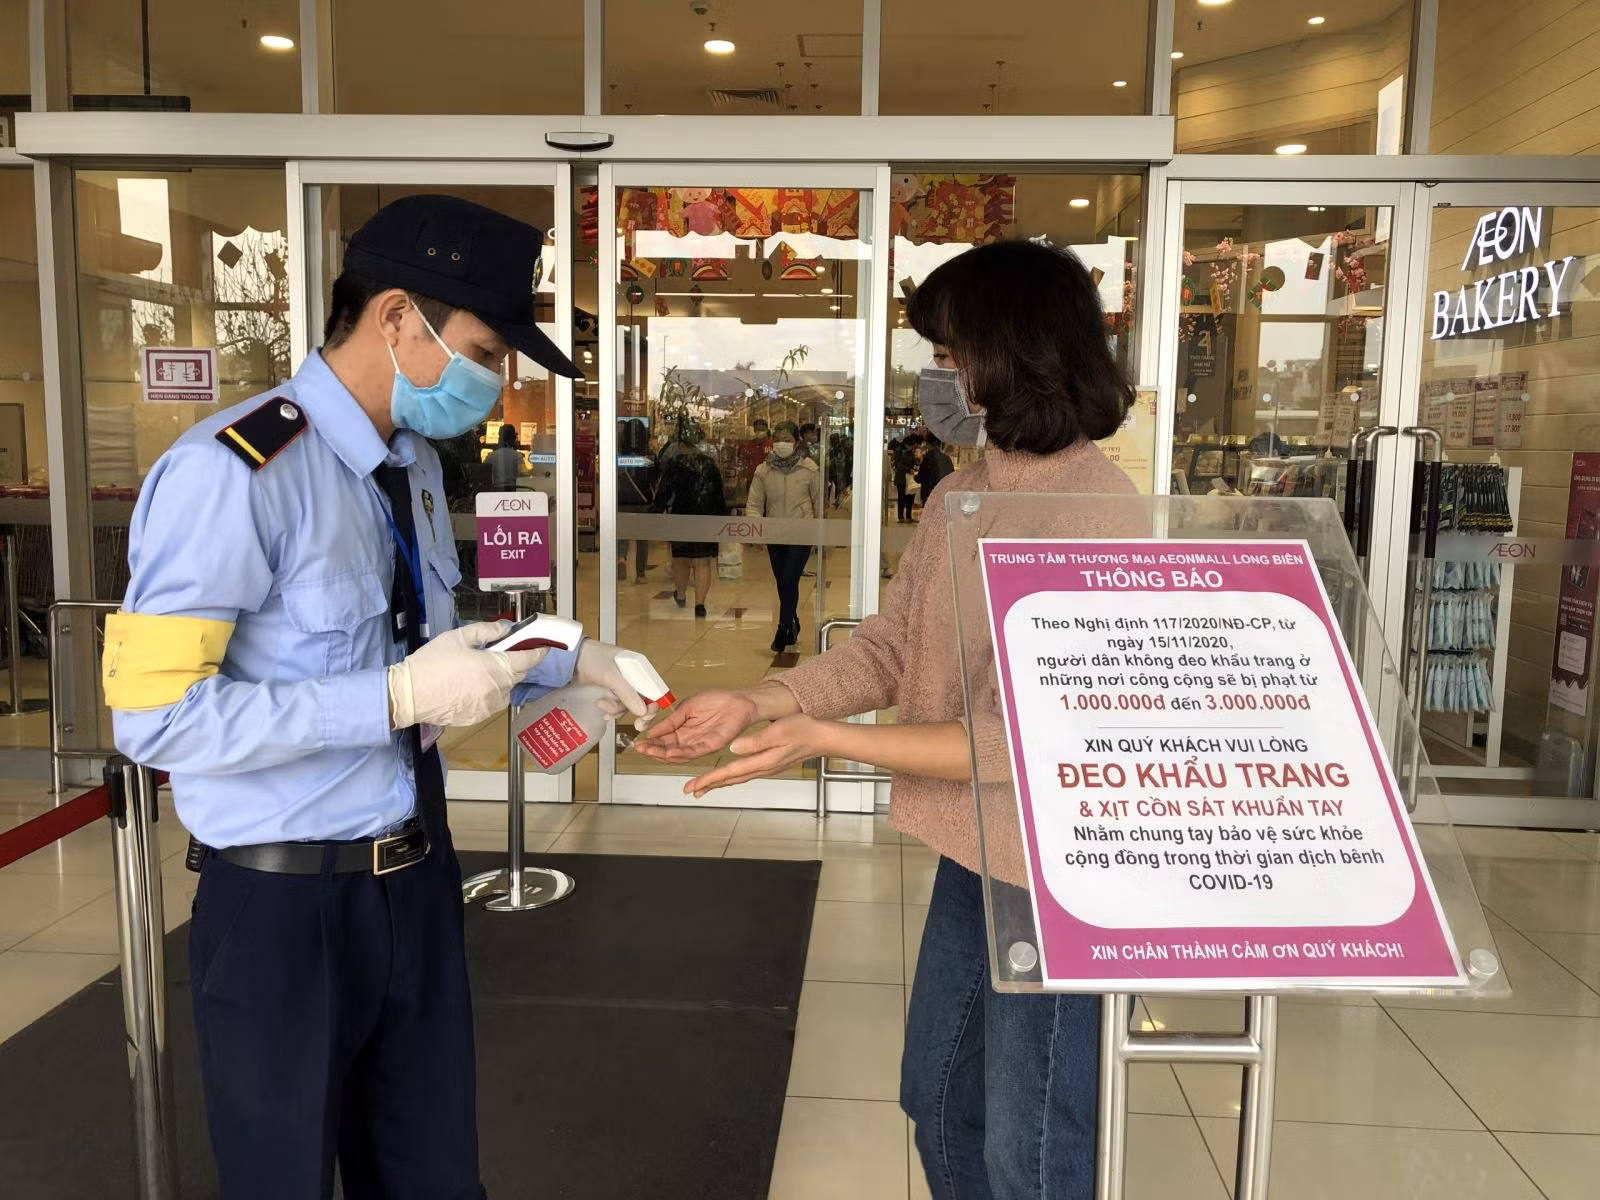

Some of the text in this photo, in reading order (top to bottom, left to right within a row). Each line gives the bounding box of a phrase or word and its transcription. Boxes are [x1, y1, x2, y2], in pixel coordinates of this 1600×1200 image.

[1430, 255, 1577, 340] BAKERY
[483, 525, 543, 546] LỐI RA
[500, 549, 526, 560] EXIT
[989, 552, 1304, 566] TRUNG TÂM THƯƠNG MẠI AEONMALL LONG BIÊN
[1080, 567, 1224, 588] THÔNG BÁO
[1031, 617, 1296, 632] Theo Nghị định 117/2020/NĐ-CP, từ
[1107, 636, 1234, 651] ngày 15/11/2020,
[1037, 653, 1311, 669] người dân không đeo khẩu trang ở
[1040, 673, 1318, 689] những nơi công cộng sẽ bị phạt từ
[1060, 694, 1311, 710] 1.000.000đ đến 3.000.000đ
[1084, 736, 1308, 753] XIN QUÝ KHÁCH VUI LÒNG
[1057, 755, 1350, 789] ĐEO KHẨU TRANG
[1079, 795, 1344, 821] & XỊT CỒN SÁT KHUẨN TAY
[1073, 825, 1364, 845] Nhằm chung tay bảo vệ sức khỏe
[1065, 850, 1110, 868] cộng
[1114, 849, 1160, 869] đồng
[1164, 850, 1211, 869] trong
[1214, 849, 1252, 865] thời
[1256, 849, 1294, 869] gian
[1298, 849, 1337, 867] dịch
[1188, 874, 1274, 890] COVID-19
[1091, 940, 1405, 960] XIN CHÂN THÀNH CẢM ƠN QUÝ KHÁCH!
